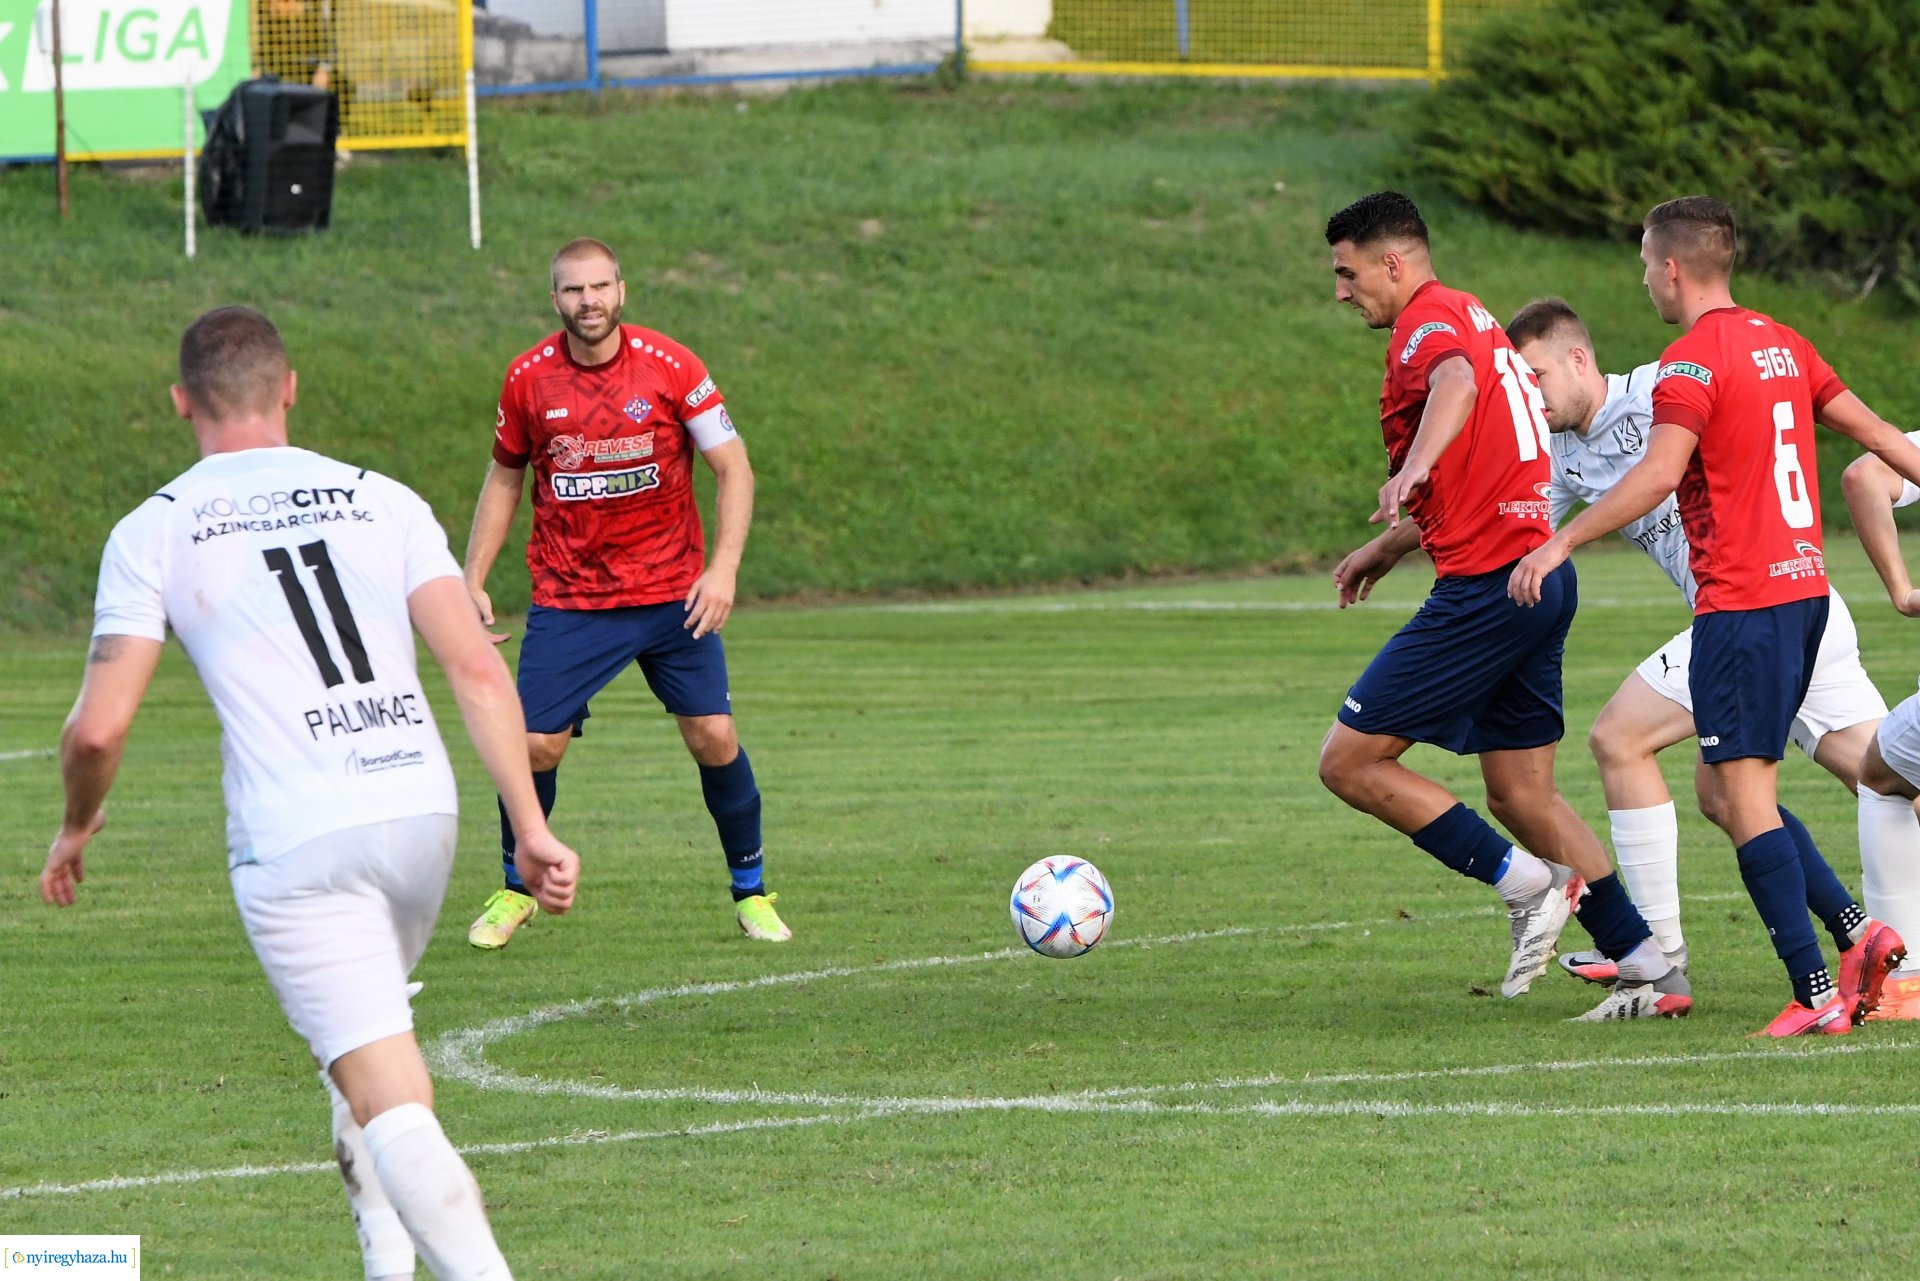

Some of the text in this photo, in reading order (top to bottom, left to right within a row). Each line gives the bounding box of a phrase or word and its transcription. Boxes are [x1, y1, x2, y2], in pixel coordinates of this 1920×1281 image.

[546, 408, 568, 419] JAKO
[1773, 401, 1813, 528] 6
[192, 488, 355, 523] KOLORCITY
[1498, 500, 1551, 515] LERTO
[191, 510, 375, 545] KAZINCBARCIKA SC
[262, 539, 375, 689] 11
[1344, 696, 1362, 713] JAKO
[1698, 736, 1720, 747] AKO
